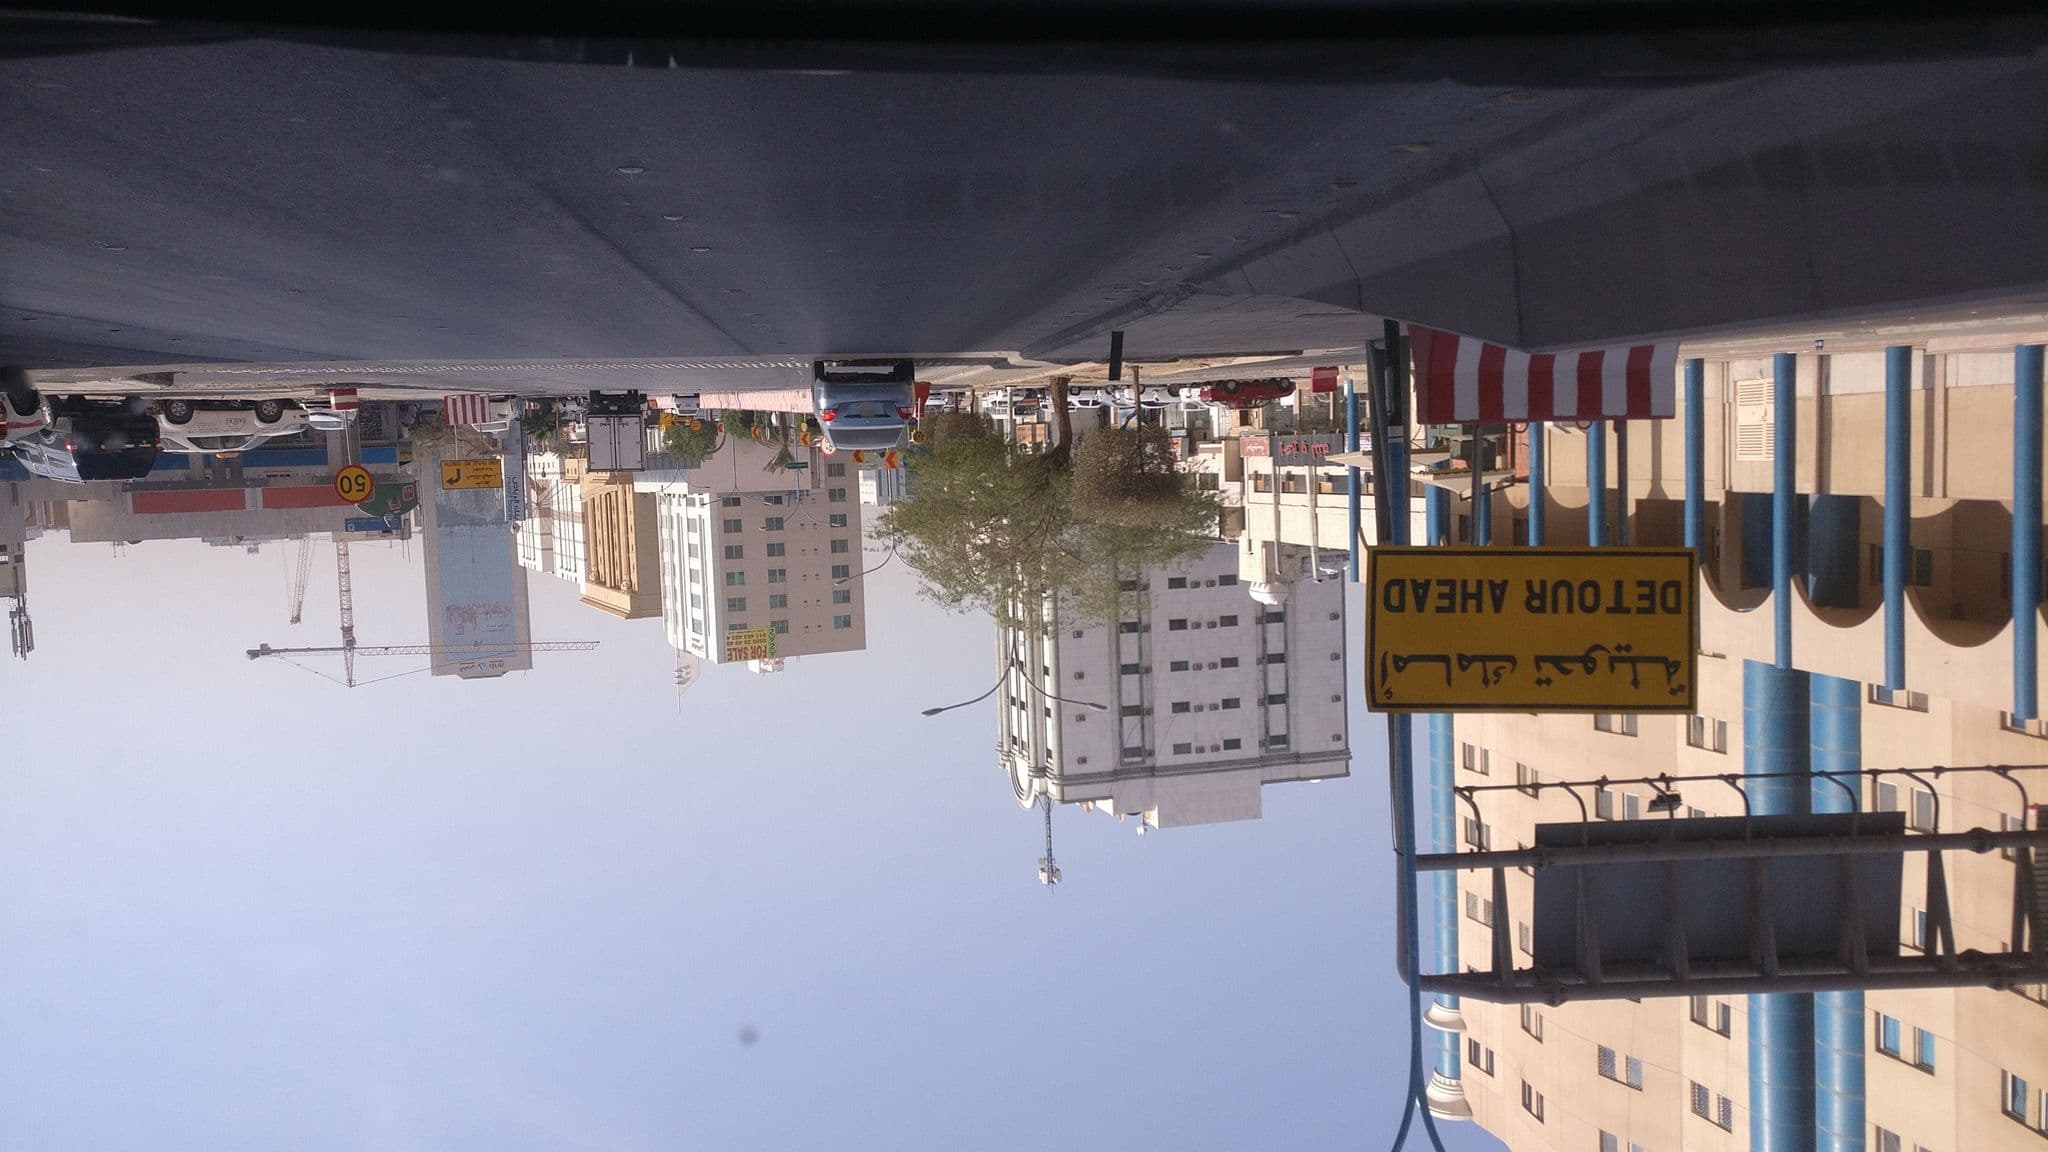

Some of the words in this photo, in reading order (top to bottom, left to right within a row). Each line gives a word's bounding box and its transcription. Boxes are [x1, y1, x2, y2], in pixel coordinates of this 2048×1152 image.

[340, 474, 366, 494] 50
[1383, 578, 1508, 614] AHEAD
[1524, 580, 1682, 614] DETOUR
[727, 646, 748, 662] SALE
[750, 644, 768, 660] FOR
[1380, 650, 1518, 702] أمامك
[1533, 644, 1686, 696] تحويلة
